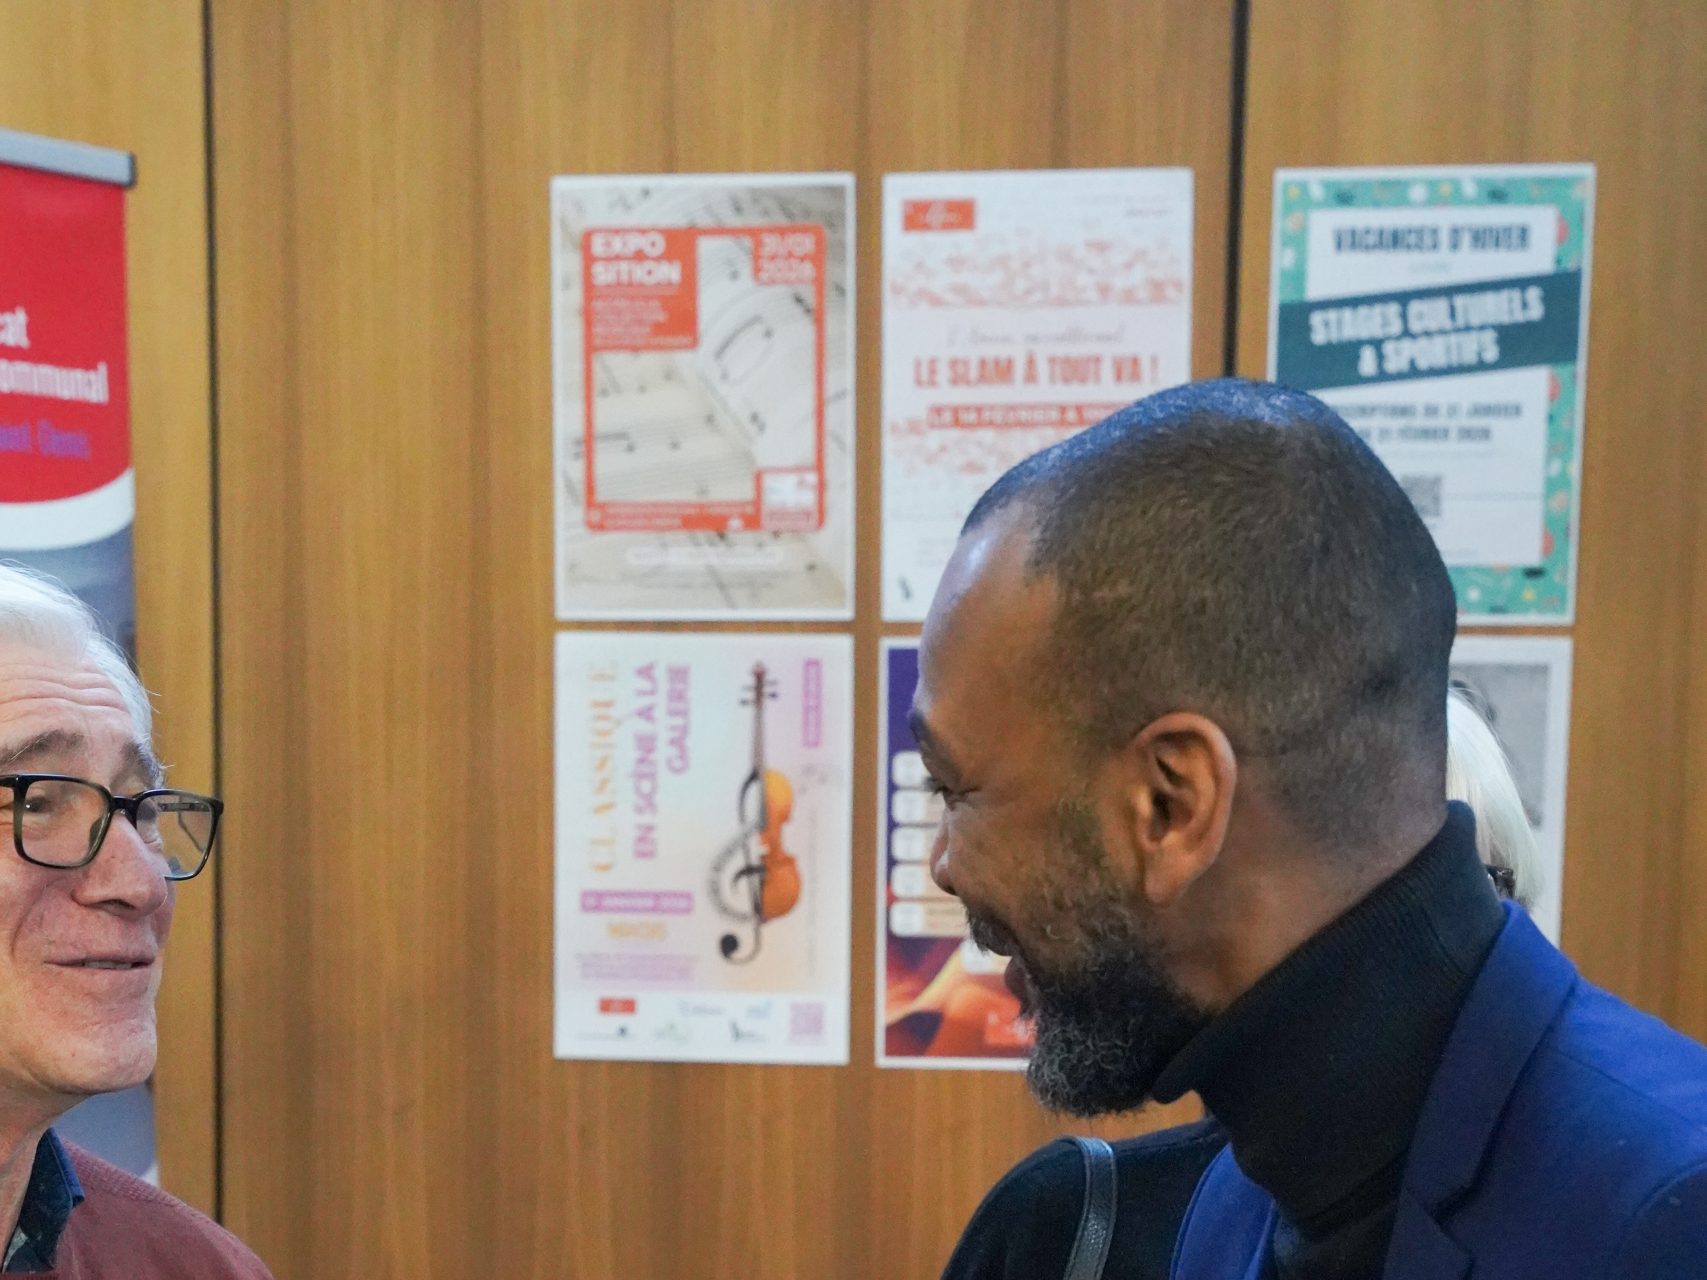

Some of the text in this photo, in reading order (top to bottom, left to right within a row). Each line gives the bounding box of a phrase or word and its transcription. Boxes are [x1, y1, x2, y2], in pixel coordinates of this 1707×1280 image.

[591, 231, 666, 257] EXPO
[1334, 224, 1529, 252] VACANCES D'HIVER
[591, 260, 682, 287] SITION
[1309, 285, 1546, 346] STAGES CULTURELS
[914, 356, 940, 387] LE
[948, 355, 1014, 386] SLAM
[1023, 350, 1039, 385] À
[1047, 353, 1103, 385] TOUT
[1111, 354, 1142, 385] VA
[1381, 327, 1501, 375] SPORTIFS
[633, 661, 658, 698] LA
[665, 664, 690, 776] GALERIE
[590, 660, 622, 875] CLASSIQUE
[633, 823, 658, 859] EN
